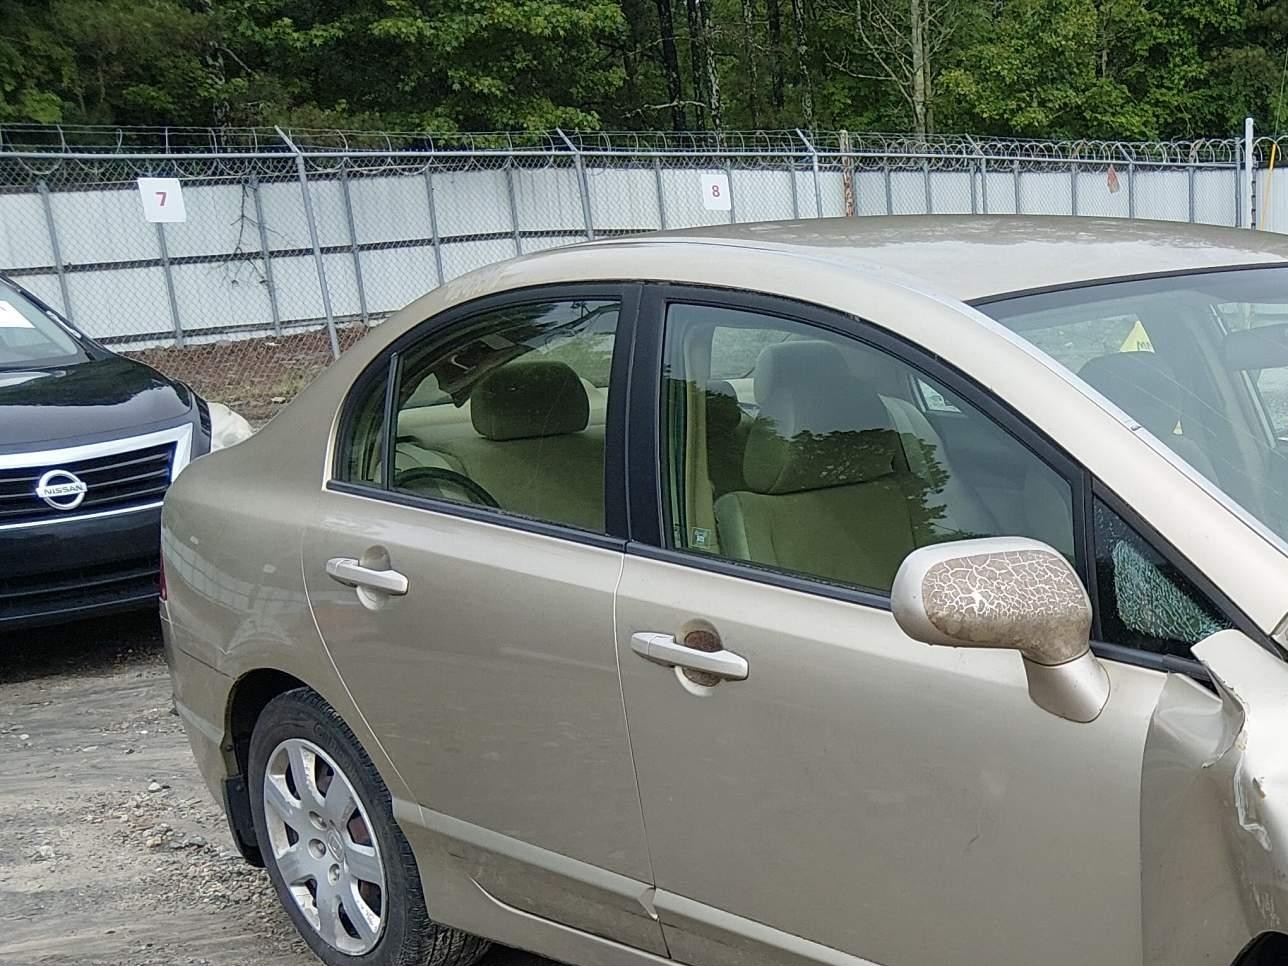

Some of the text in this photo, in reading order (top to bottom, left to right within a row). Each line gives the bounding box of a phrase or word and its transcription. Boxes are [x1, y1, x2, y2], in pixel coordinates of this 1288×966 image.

[711, 185, 721, 198] 8
[155, 191, 167, 207] 7
[43, 485, 83, 495] NISSAN
